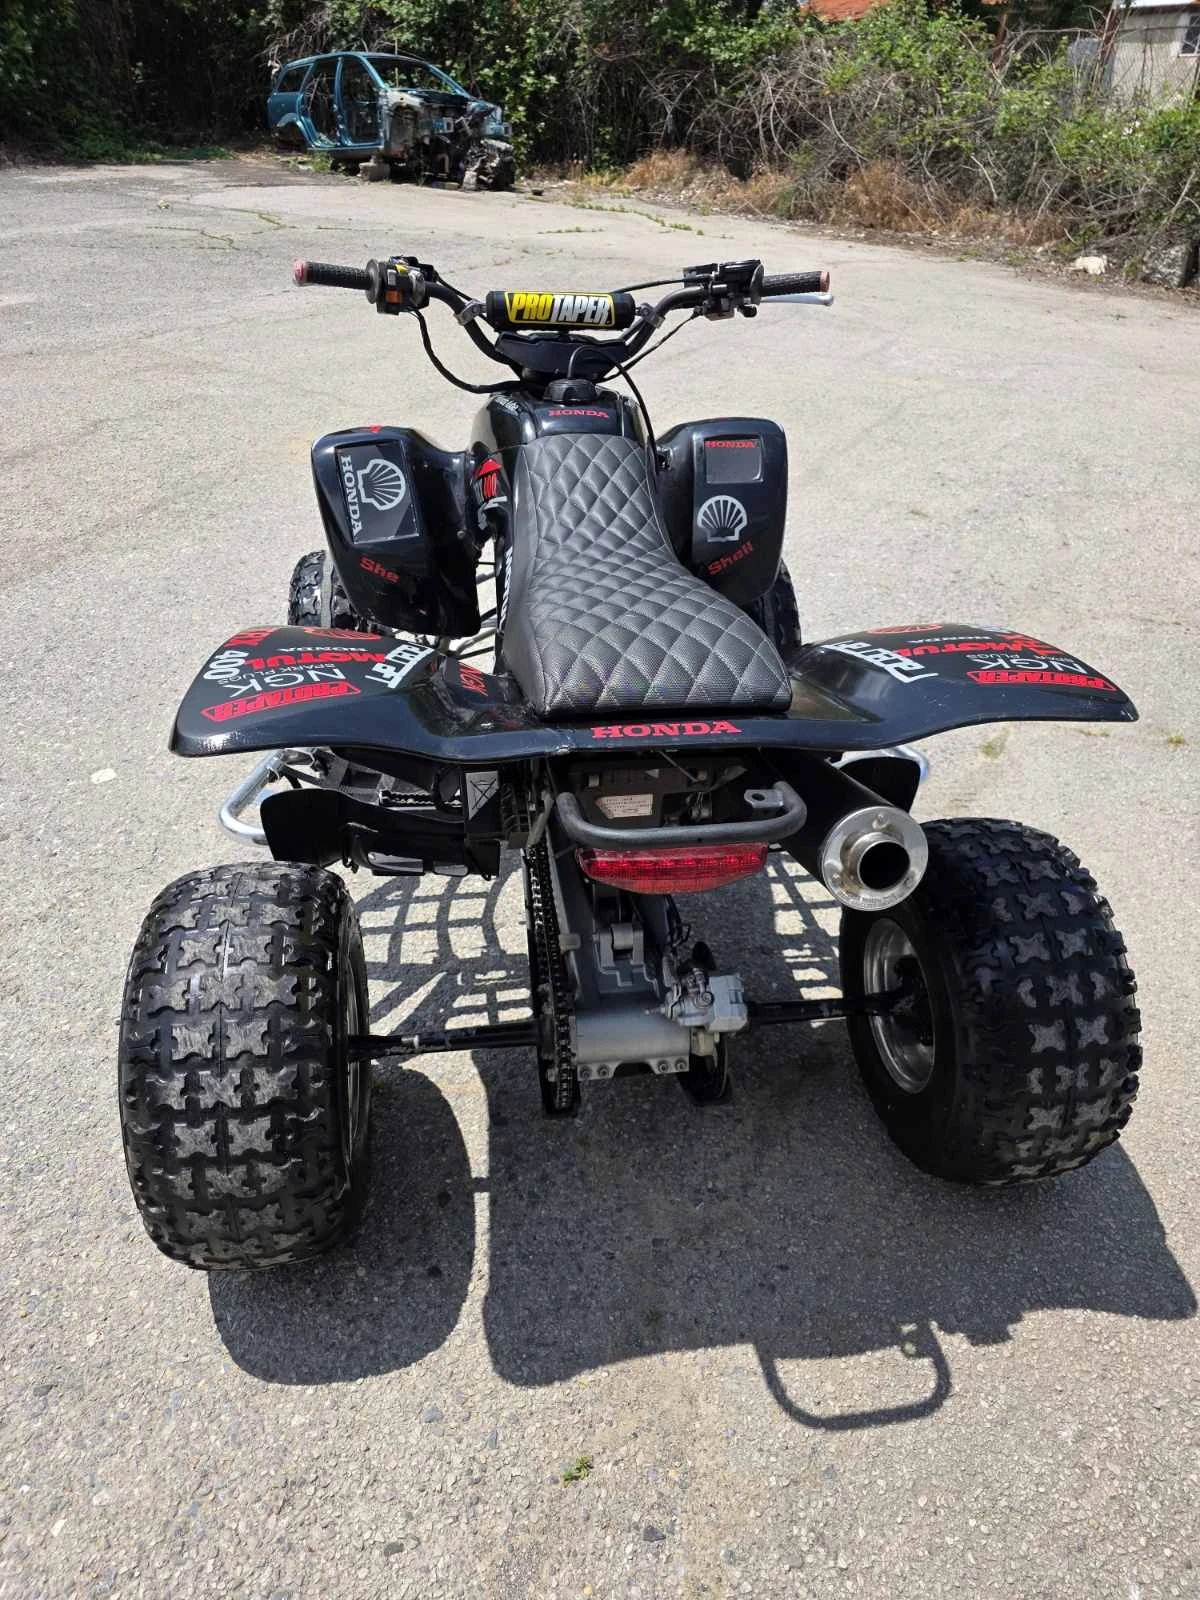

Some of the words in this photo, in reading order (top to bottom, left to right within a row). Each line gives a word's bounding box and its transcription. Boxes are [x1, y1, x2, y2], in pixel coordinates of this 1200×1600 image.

[511, 293, 611, 324] PROTAPER
[549, 409, 609, 418] HONDA
[704, 440, 757, 449] HONDA
[341, 455, 362, 538] HONDA
[204, 650, 249, 680] 400
[244, 652, 386, 670] MOTUL
[969, 658, 1087, 675] NGK
[223, 667, 346, 698] NGK
[213, 683, 350, 722] PROTAPER
[592, 720, 742, 740] HONDA
